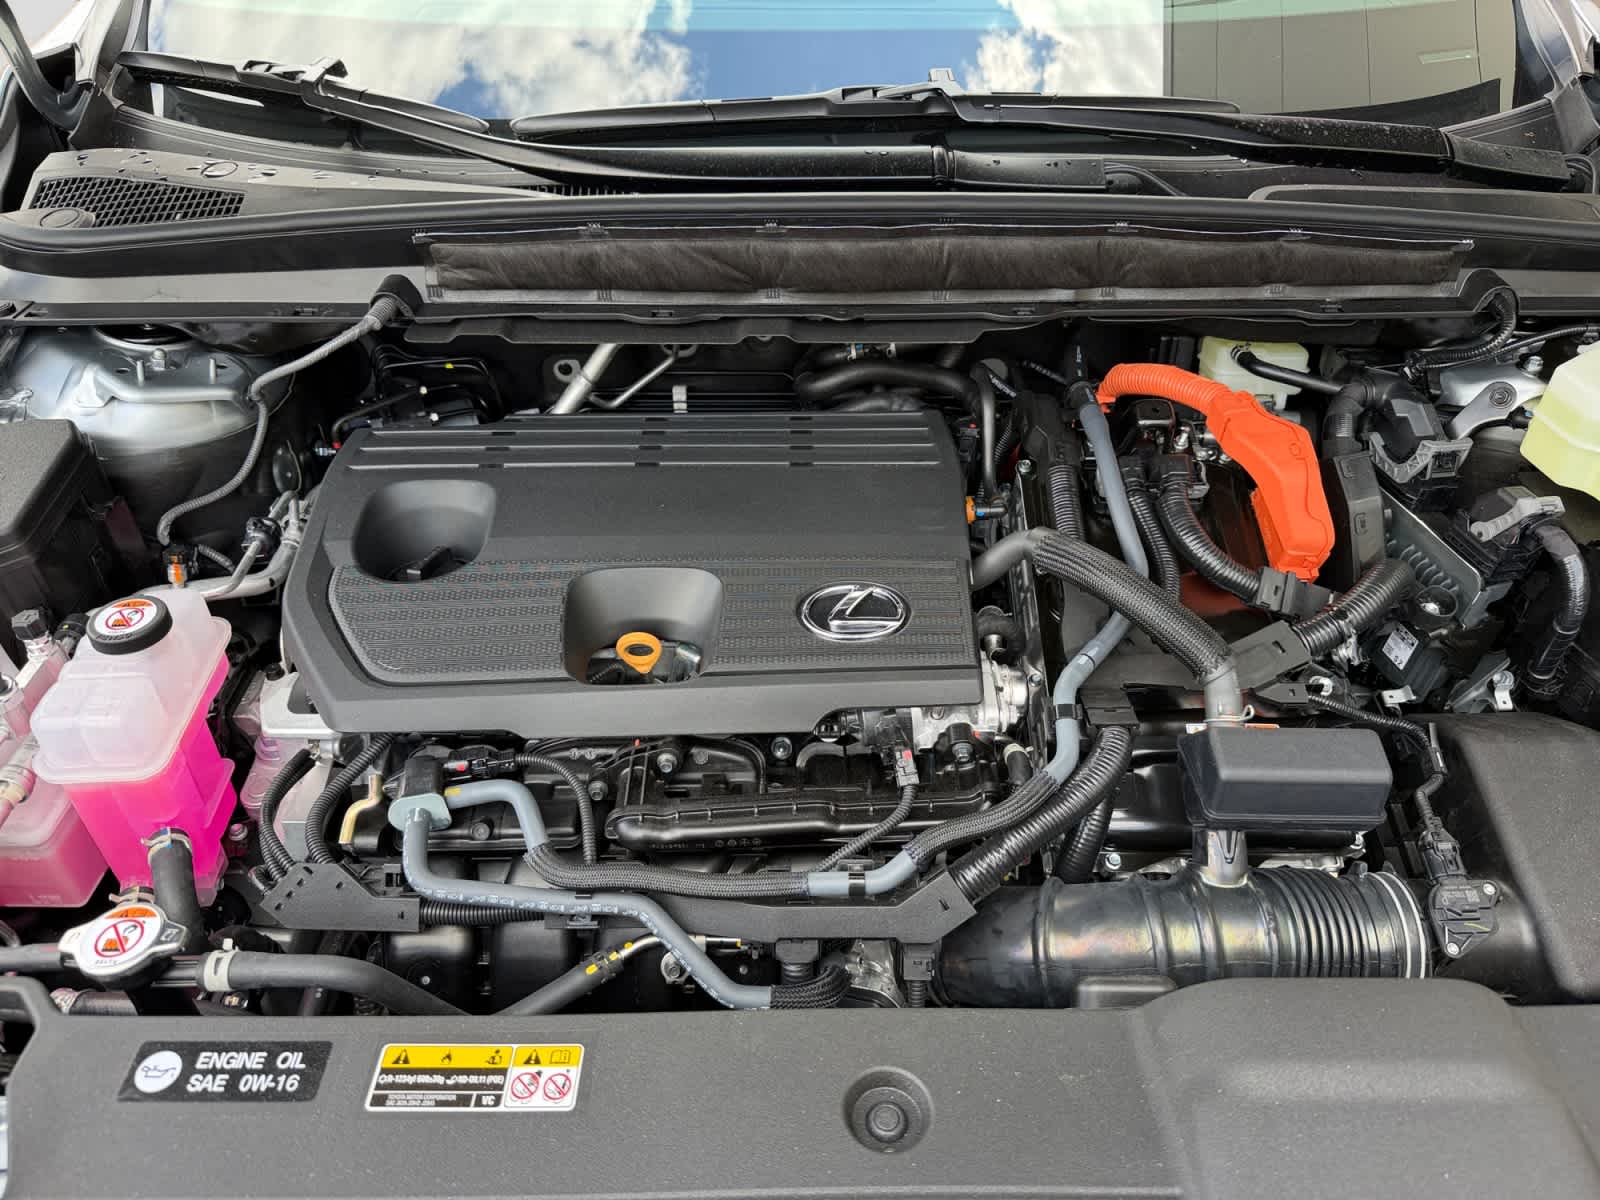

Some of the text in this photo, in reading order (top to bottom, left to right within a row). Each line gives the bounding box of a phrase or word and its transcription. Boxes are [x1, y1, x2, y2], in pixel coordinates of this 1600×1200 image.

[195, 1051, 306, 1070] ENGINE OIL
[186, 1073, 300, 1092] SAE 0W-16
[481, 1095, 496, 1106] VC
